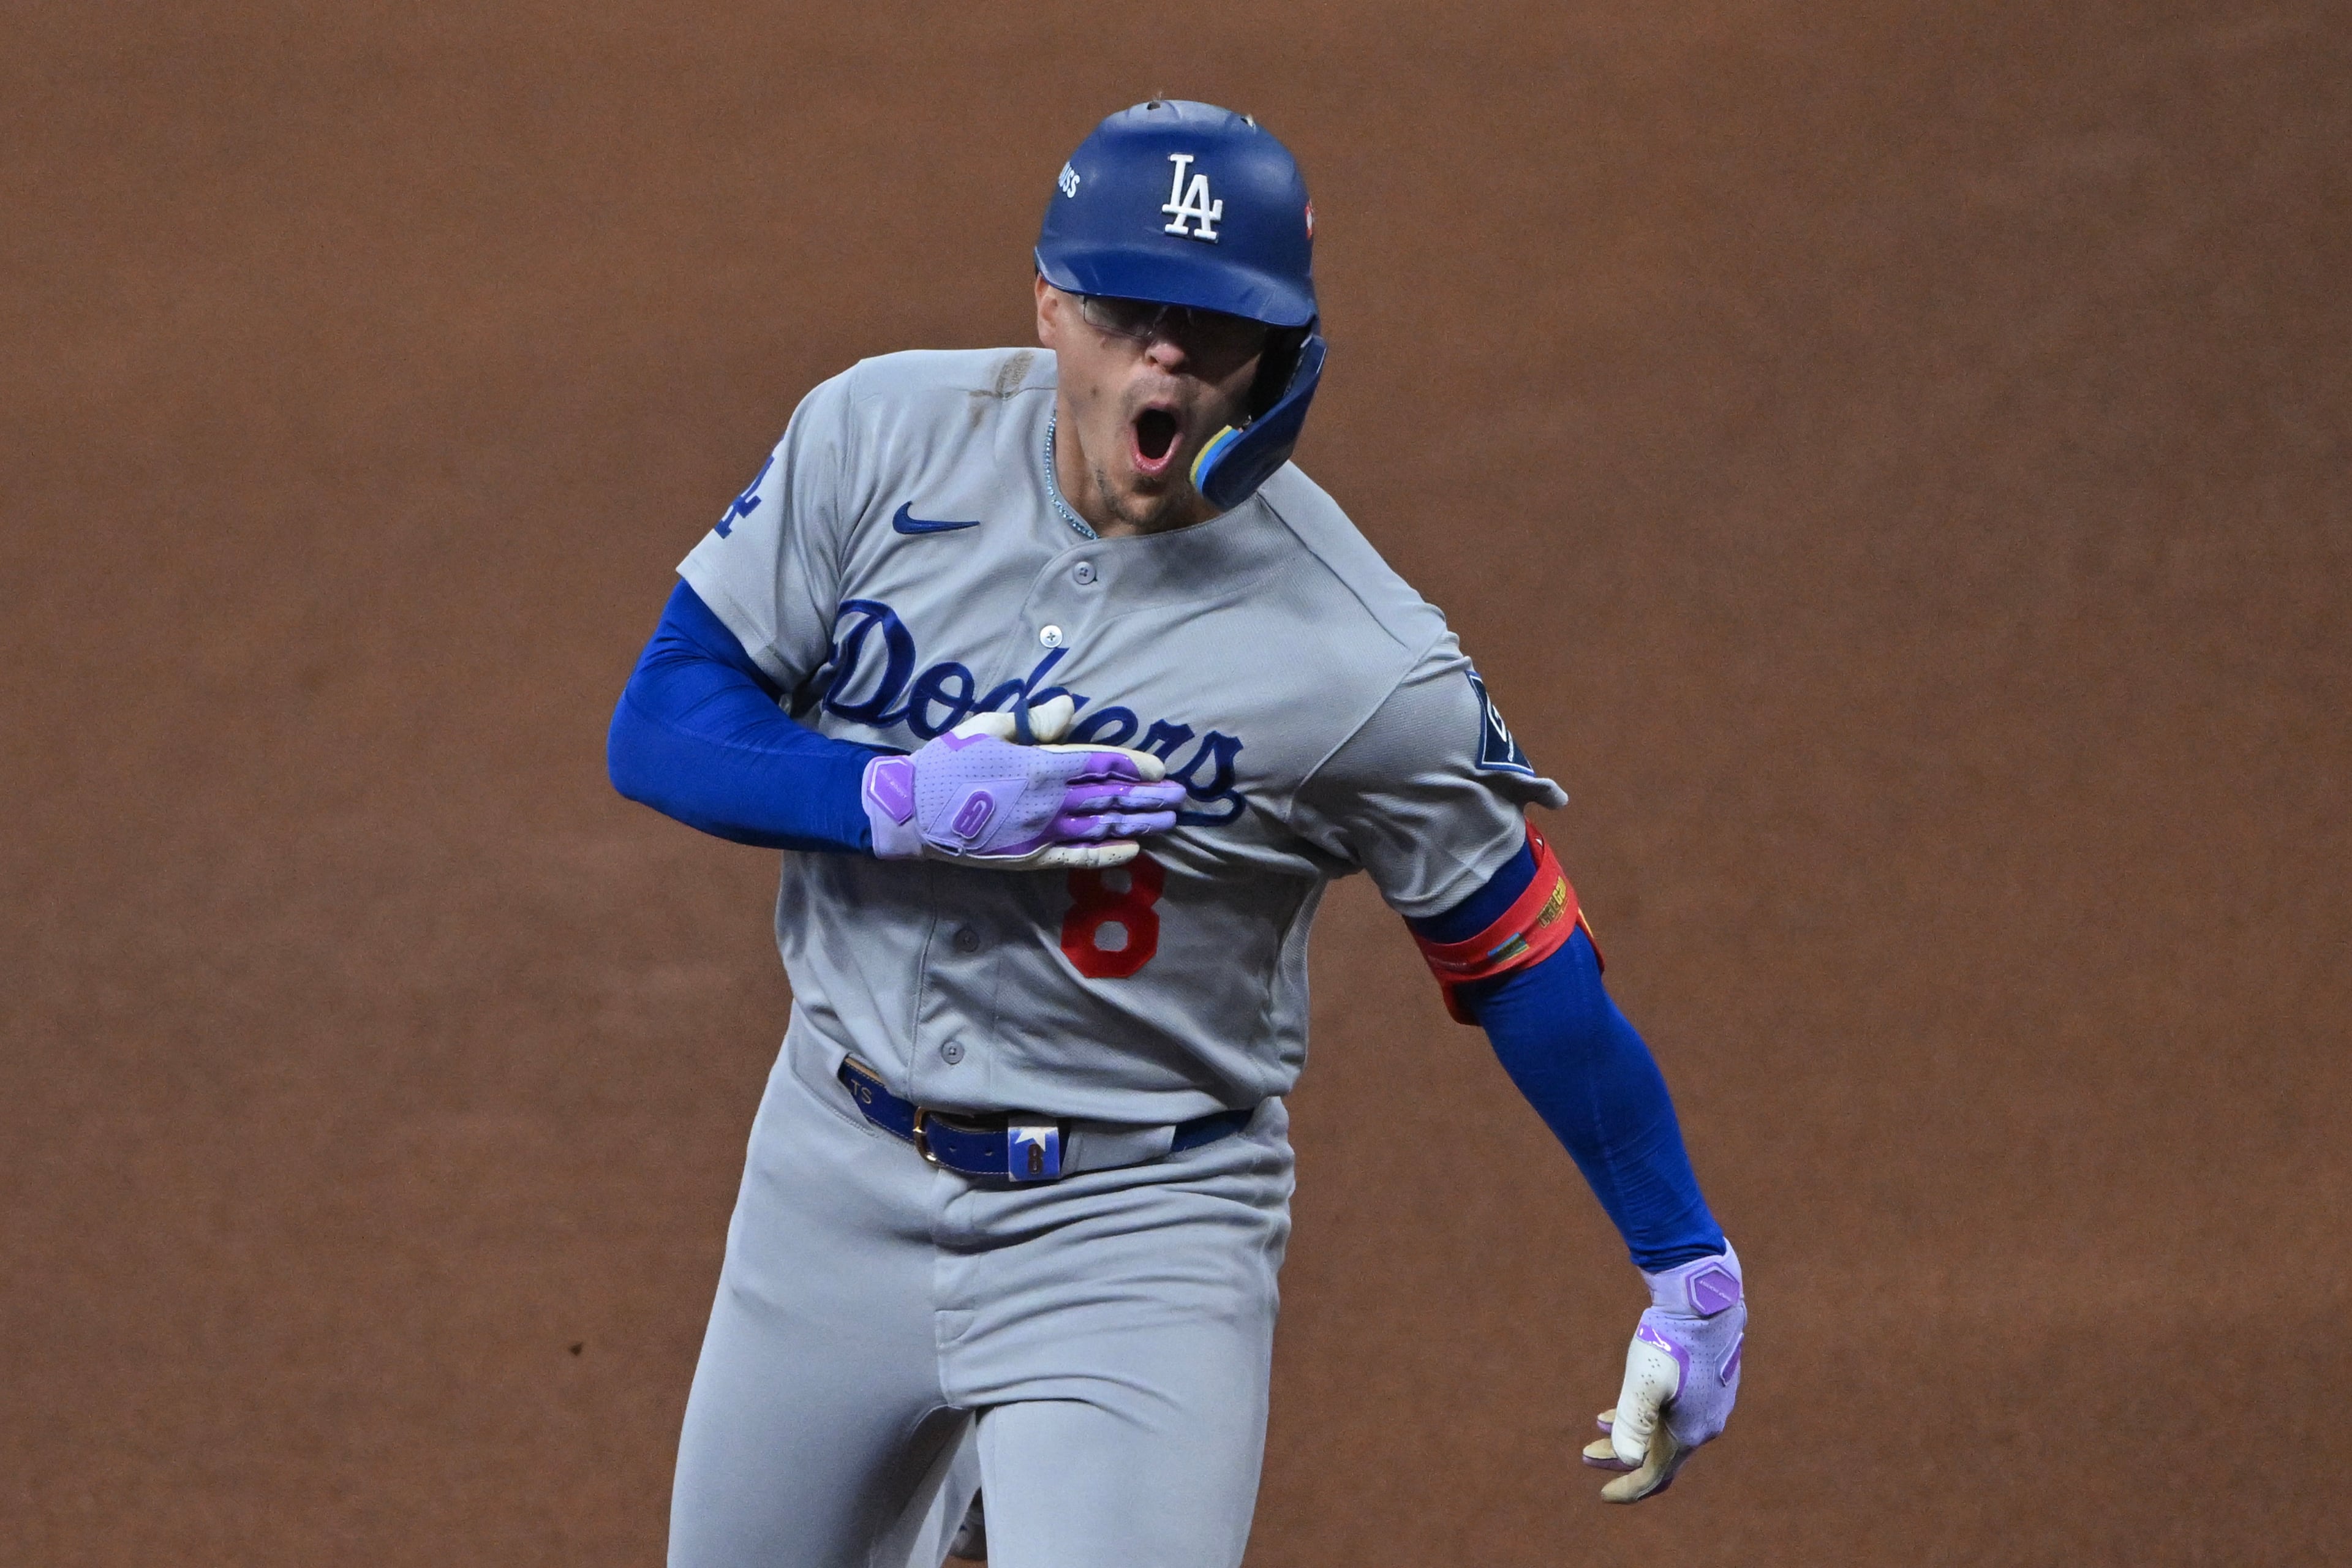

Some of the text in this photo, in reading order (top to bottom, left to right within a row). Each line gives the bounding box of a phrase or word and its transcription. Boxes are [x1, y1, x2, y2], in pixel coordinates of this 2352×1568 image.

[1162, 153, 1223, 241] LA
[1060, 850, 1166, 979] 8
[850, 1078, 872, 1104] TS
